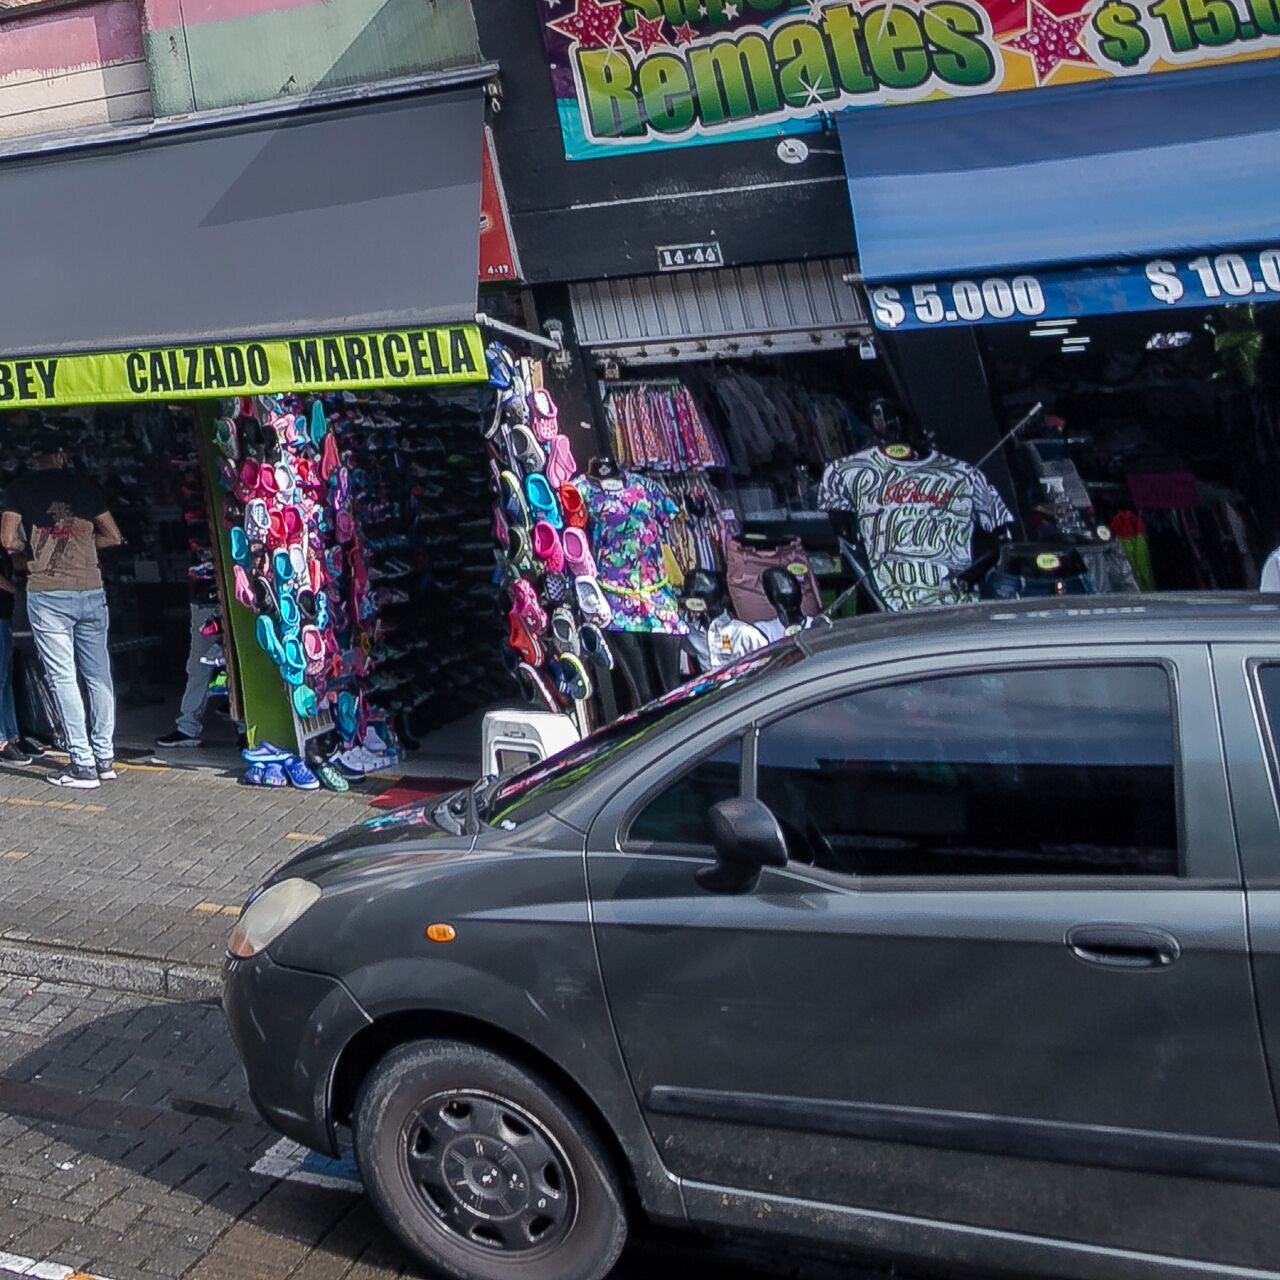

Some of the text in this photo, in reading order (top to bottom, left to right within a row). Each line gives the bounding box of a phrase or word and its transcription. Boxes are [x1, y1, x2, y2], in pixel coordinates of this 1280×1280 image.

[578, 0, 995, 139] Remates
[871, 275, 1046, 329] $ 5.000
[1145, 259, 1184, 305] $
[126, 329, 477, 393] CALZADO MARICELA
